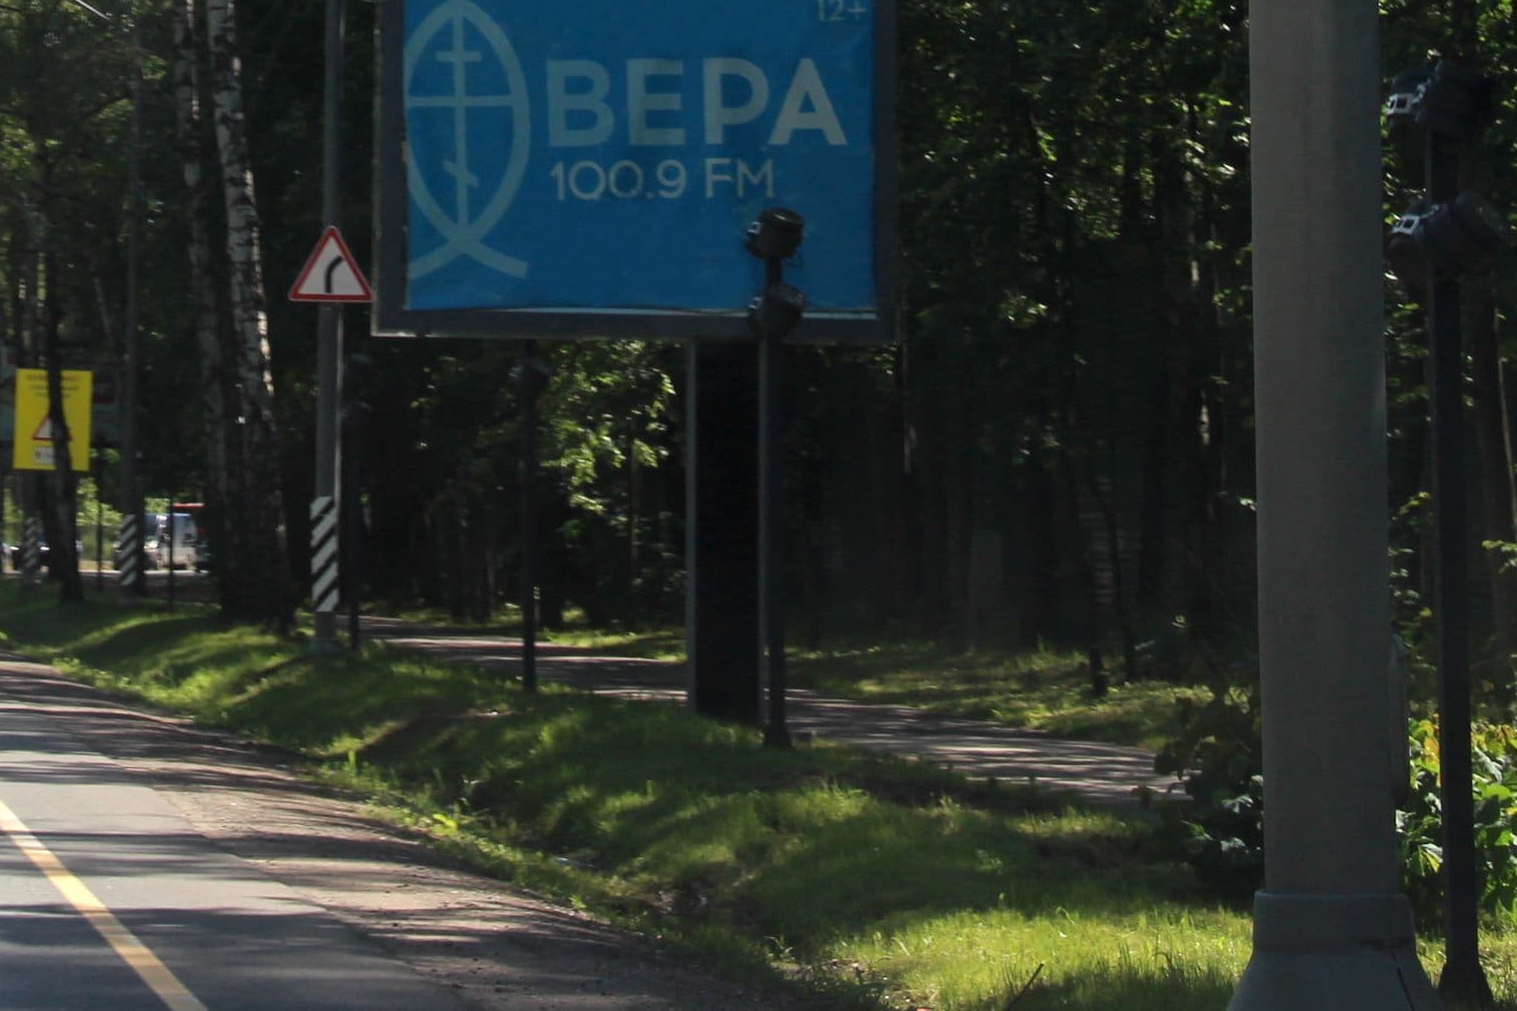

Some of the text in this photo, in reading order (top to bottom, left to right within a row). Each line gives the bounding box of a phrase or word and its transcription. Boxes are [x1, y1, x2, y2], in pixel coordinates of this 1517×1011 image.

[546, 57, 848, 147] ВЕРА
[550, 157, 776, 201] 100.9 FM
